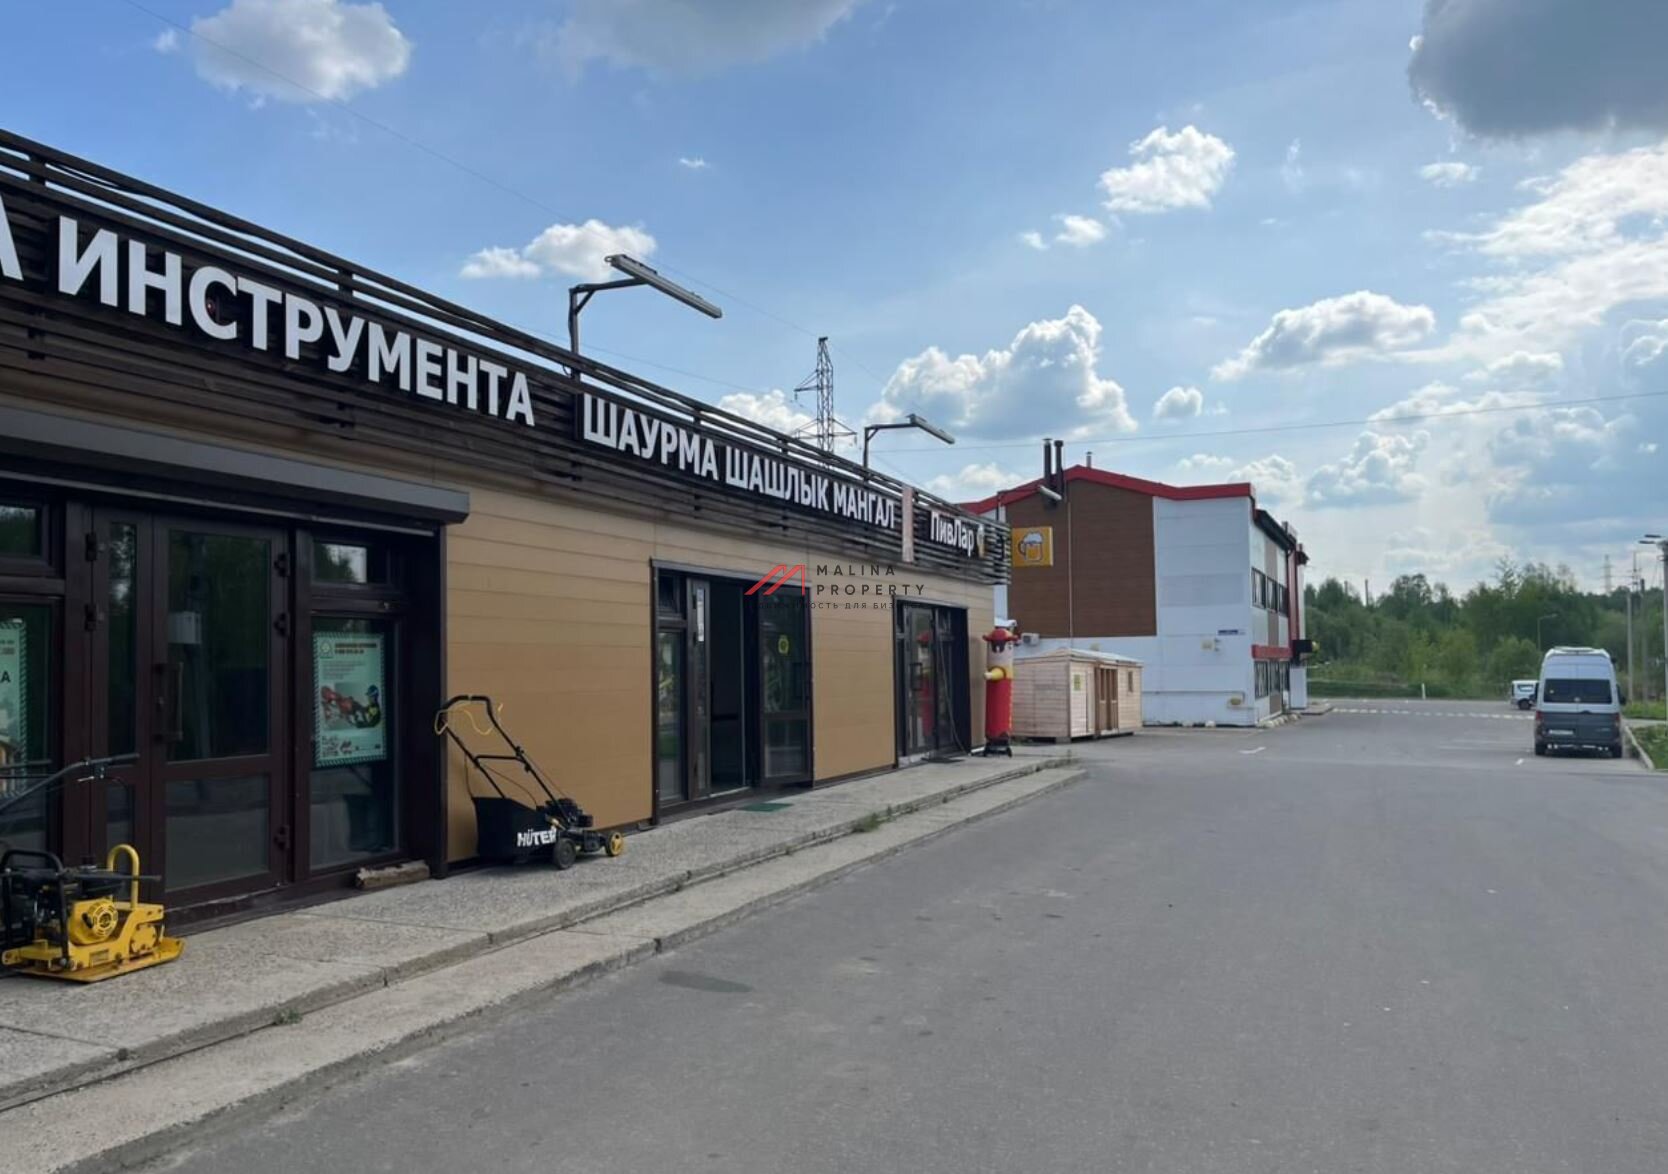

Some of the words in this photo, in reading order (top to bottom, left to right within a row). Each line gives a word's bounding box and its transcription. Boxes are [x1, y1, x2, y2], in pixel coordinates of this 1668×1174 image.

[59, 215, 535, 427] ИНСТРУМЕНТА
[584, 393, 719, 480] ШАУРМА
[725, 445, 829, 512] ШАШЛЫК
[833, 484, 896, 529] МАНГАЛ
[930, 511, 974, 557] ПивЛар
